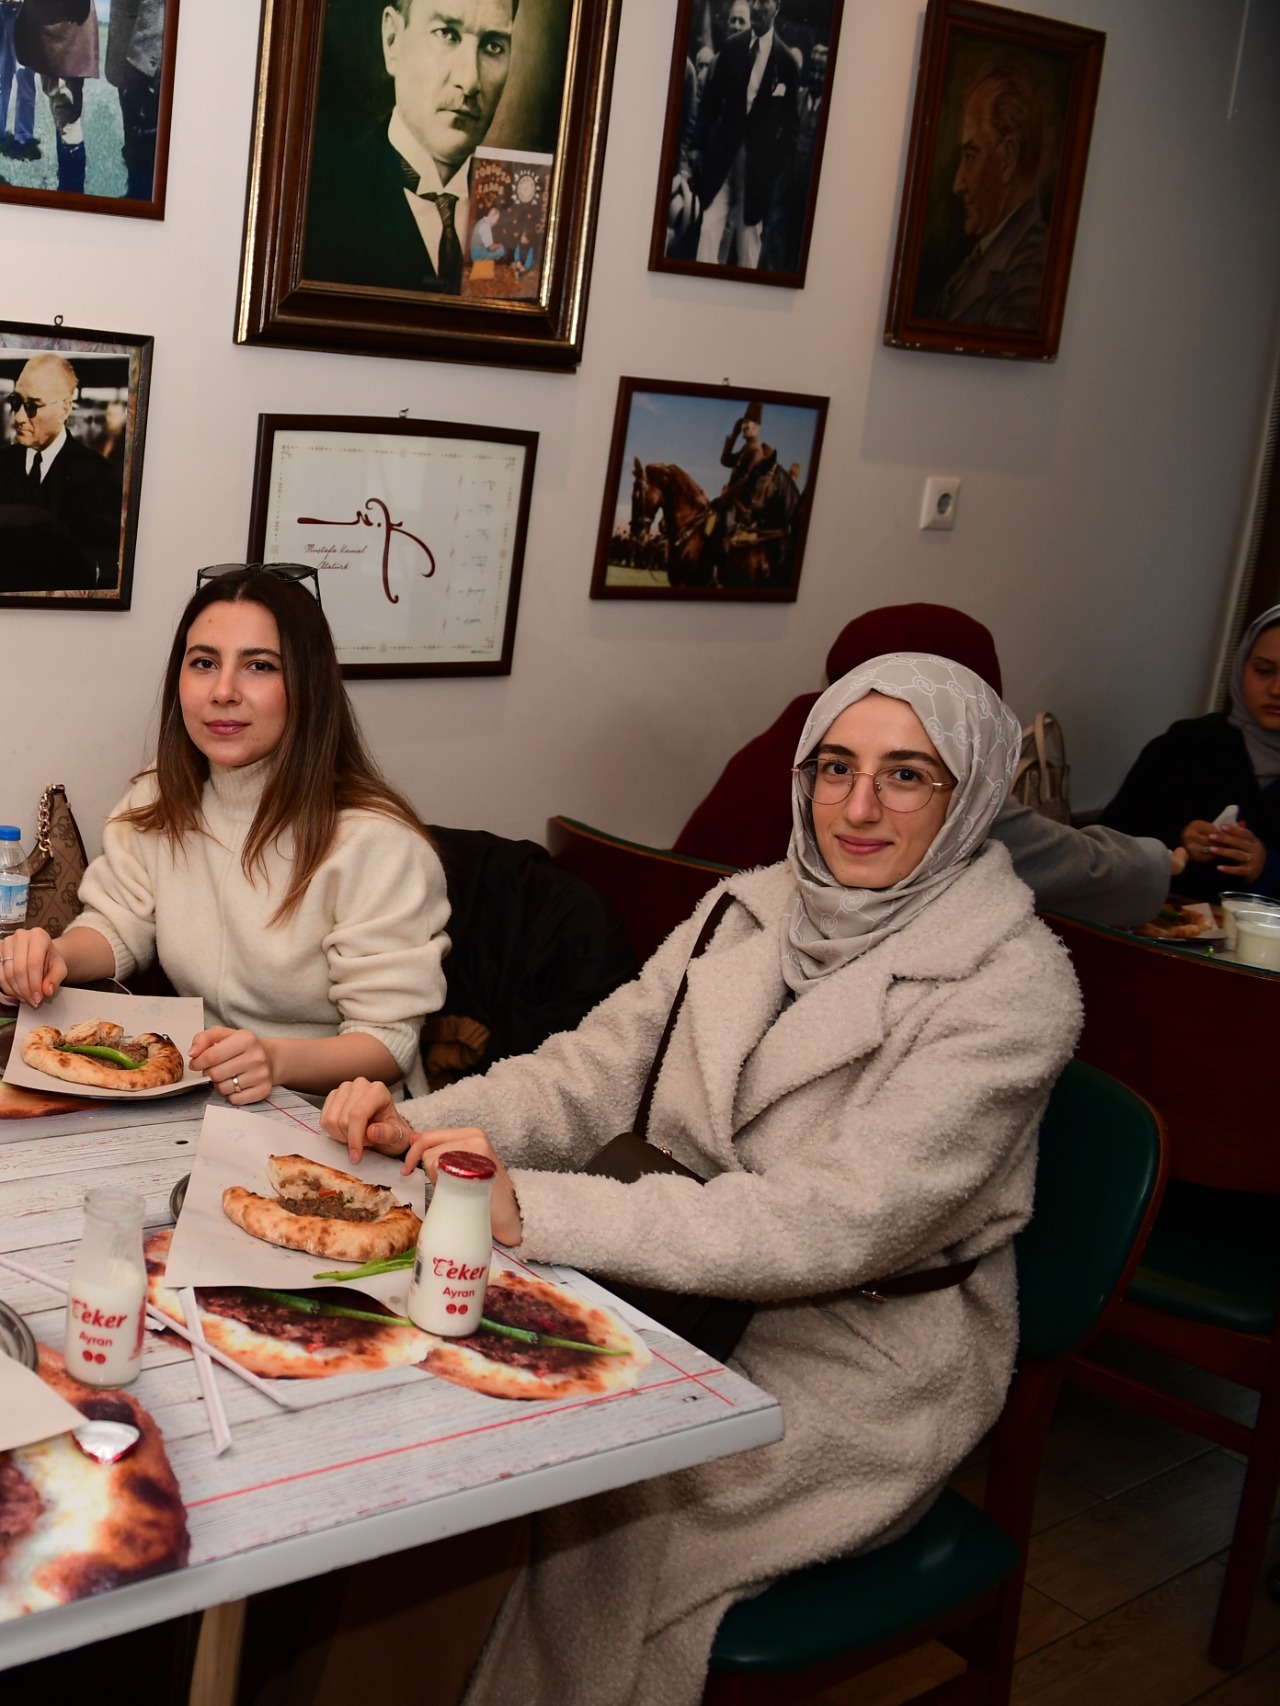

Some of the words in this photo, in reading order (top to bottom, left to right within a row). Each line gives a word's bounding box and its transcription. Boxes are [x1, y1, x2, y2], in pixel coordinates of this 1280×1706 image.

[304, 543, 337, 560] Mustafa
[338, 544, 368, 554] Kemal
[442, 1286, 475, 1299] Ayran
[79, 1331, 113, 1346] Ayran
